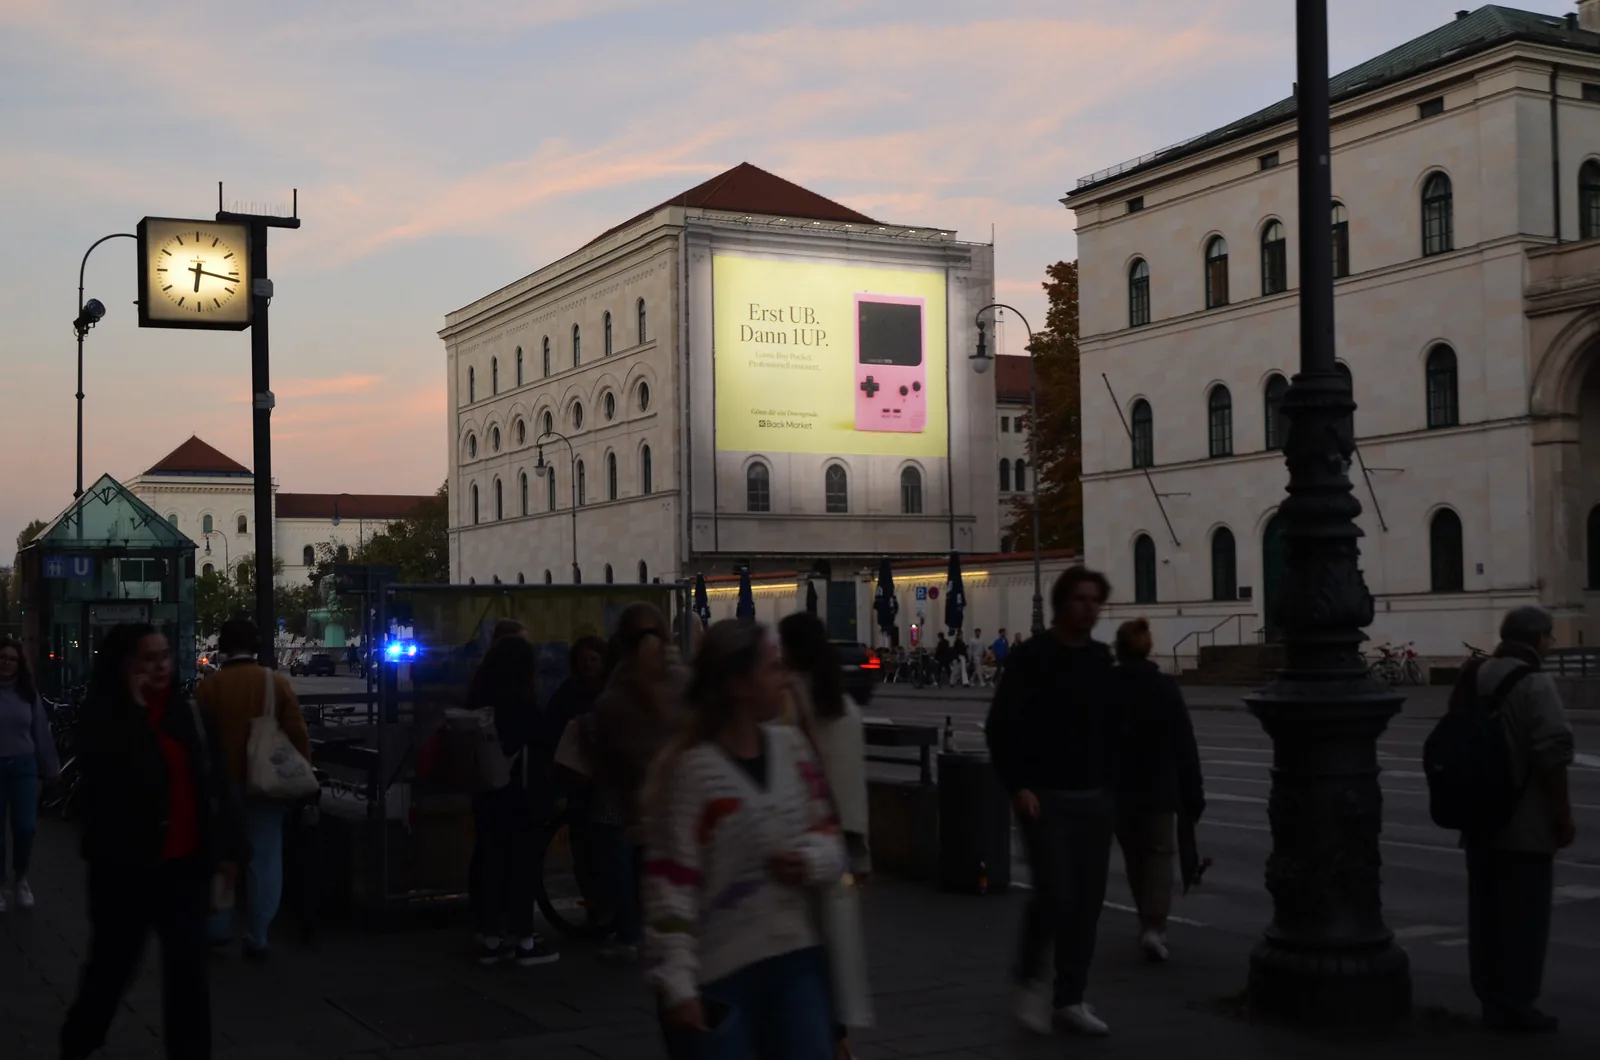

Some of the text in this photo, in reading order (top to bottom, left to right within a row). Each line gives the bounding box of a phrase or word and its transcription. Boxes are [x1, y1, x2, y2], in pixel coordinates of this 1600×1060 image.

[749, 303, 820, 325] Erst UB.
[740, 324, 829, 347] Dann 1UP.
[766, 420, 812, 429] Back Market
[74, 557, 89, 576] U
